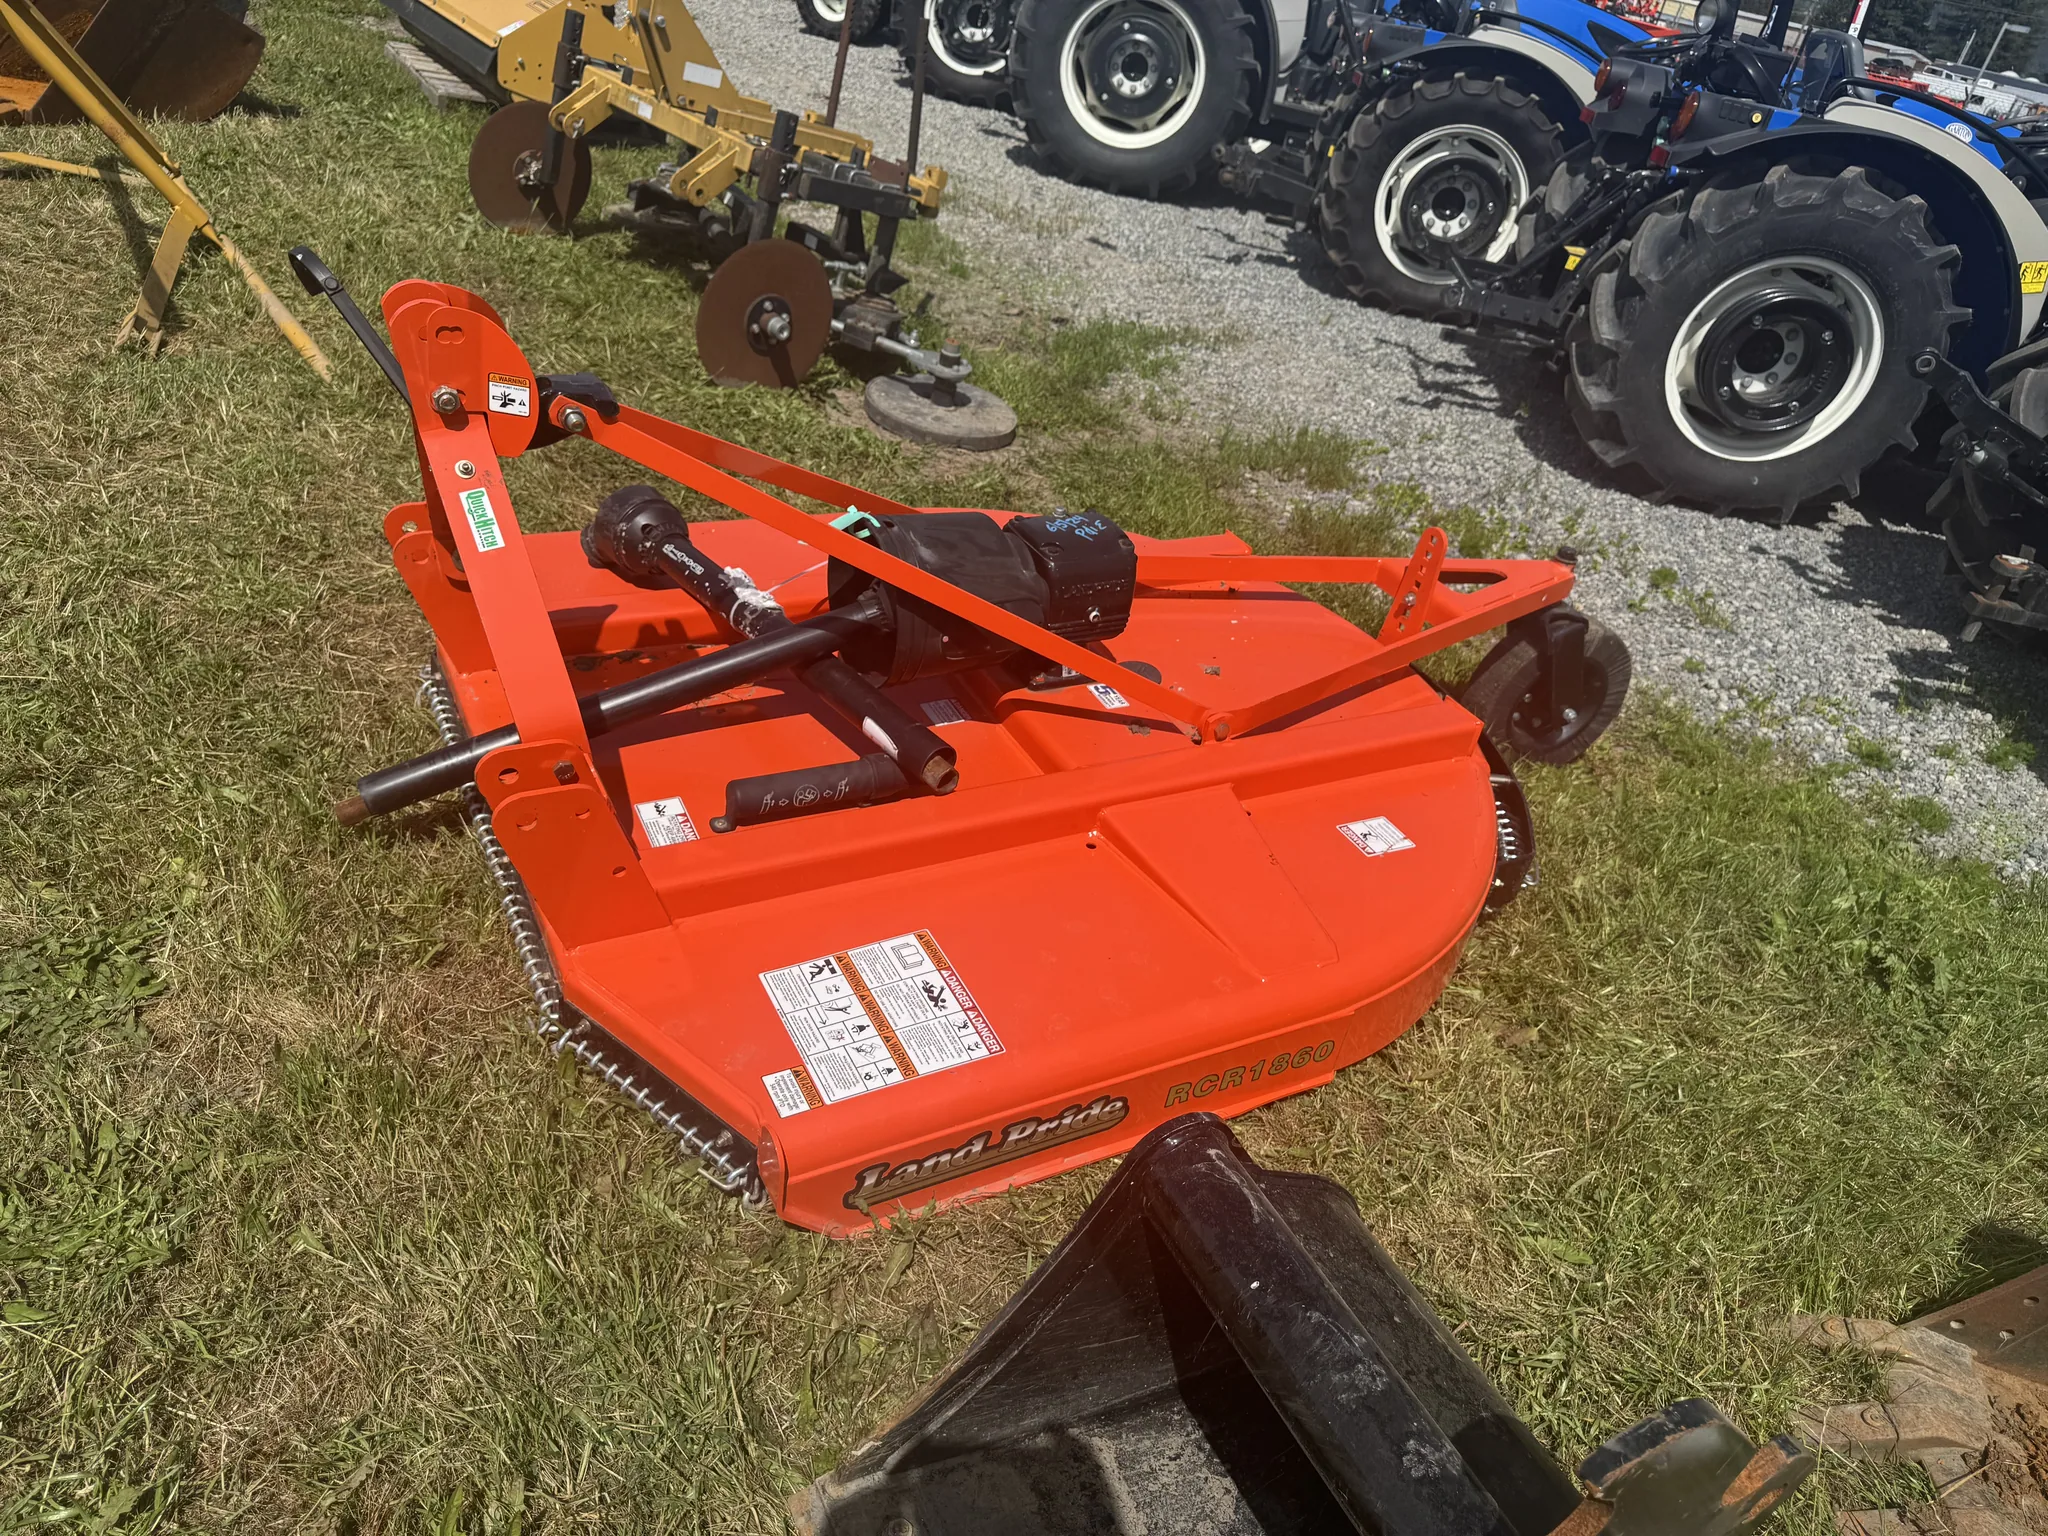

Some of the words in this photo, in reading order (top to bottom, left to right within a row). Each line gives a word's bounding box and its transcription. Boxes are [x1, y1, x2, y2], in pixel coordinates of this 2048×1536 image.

[499, 374, 526, 386] WARNING
[1340, 826, 1367, 847] DANGER
[922, 939, 947, 967] WARNING
[840, 961, 865, 991] WARNING
[946, 976, 973, 1008] DANGER
[863, 1000, 889, 1032] WARNING
[972, 1017, 1001, 1052] DANGER
[887, 1042, 915, 1076] WARNING
[1164, 1039, 1336, 1109] RCR1860
[797, 1075, 820, 1105] WARNING
[848, 1130, 987, 1202] Land
[998, 1094, 1130, 1154] Pride
